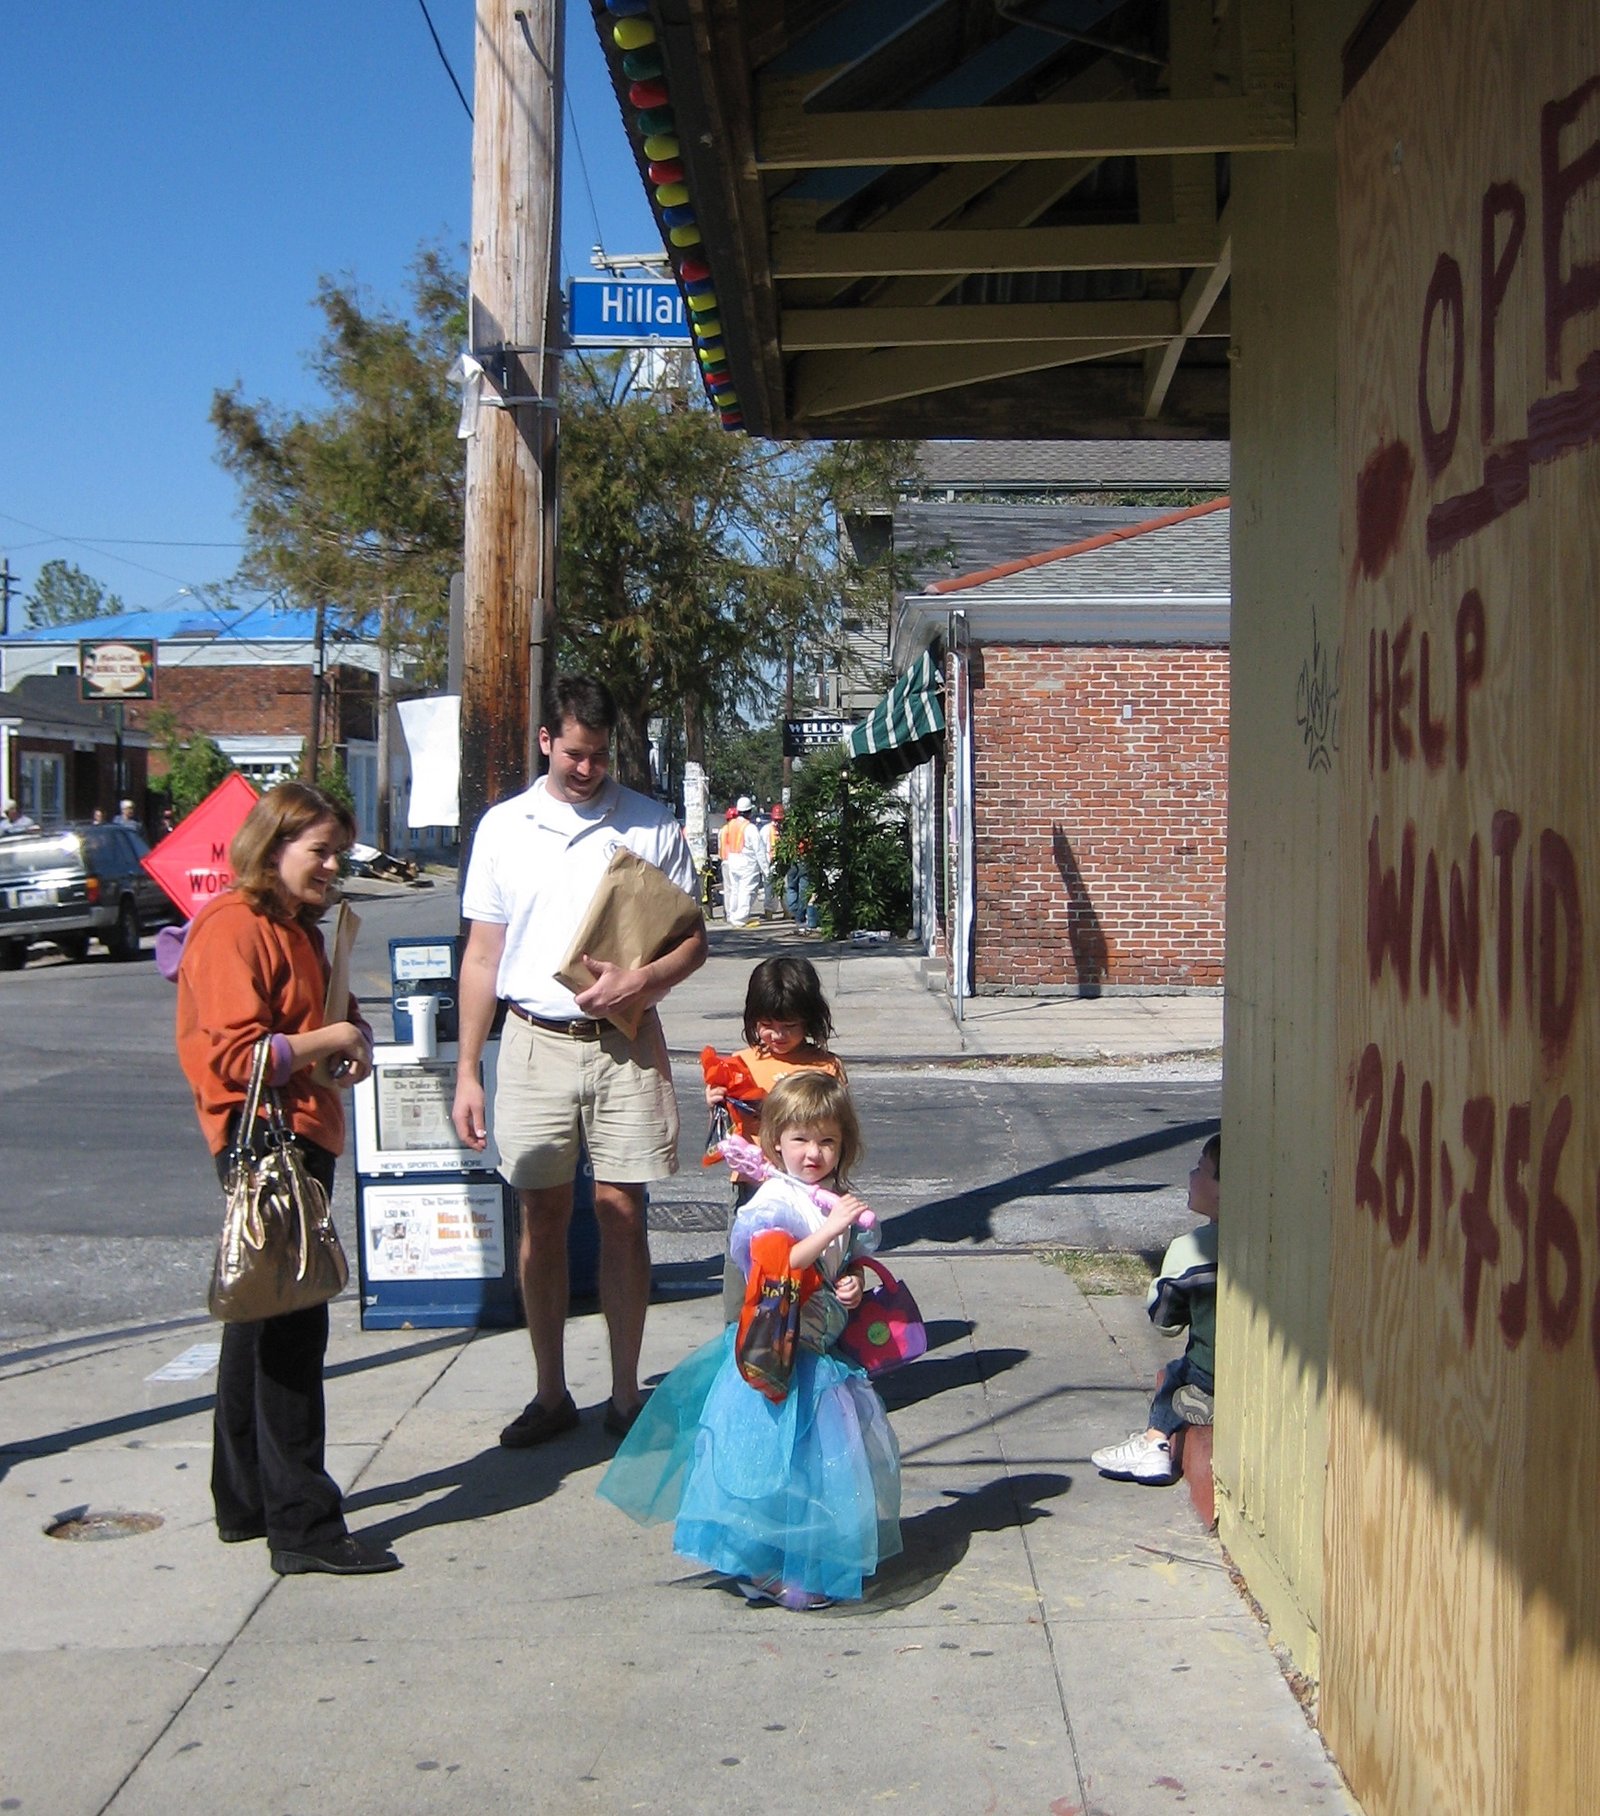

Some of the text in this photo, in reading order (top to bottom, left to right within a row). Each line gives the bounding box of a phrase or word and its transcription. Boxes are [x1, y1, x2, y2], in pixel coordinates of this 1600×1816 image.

[1369, 588, 1486, 780] HELP
[788, 722, 842, 734] WELDO
[407, 1161, 439, 1169] SPORTS,
[442, 1160, 459, 1168] AND
[461, 1160, 482, 1168] MORE
[437, 1212, 460, 1224] Miss
[438, 1227, 462, 1239] Miss
